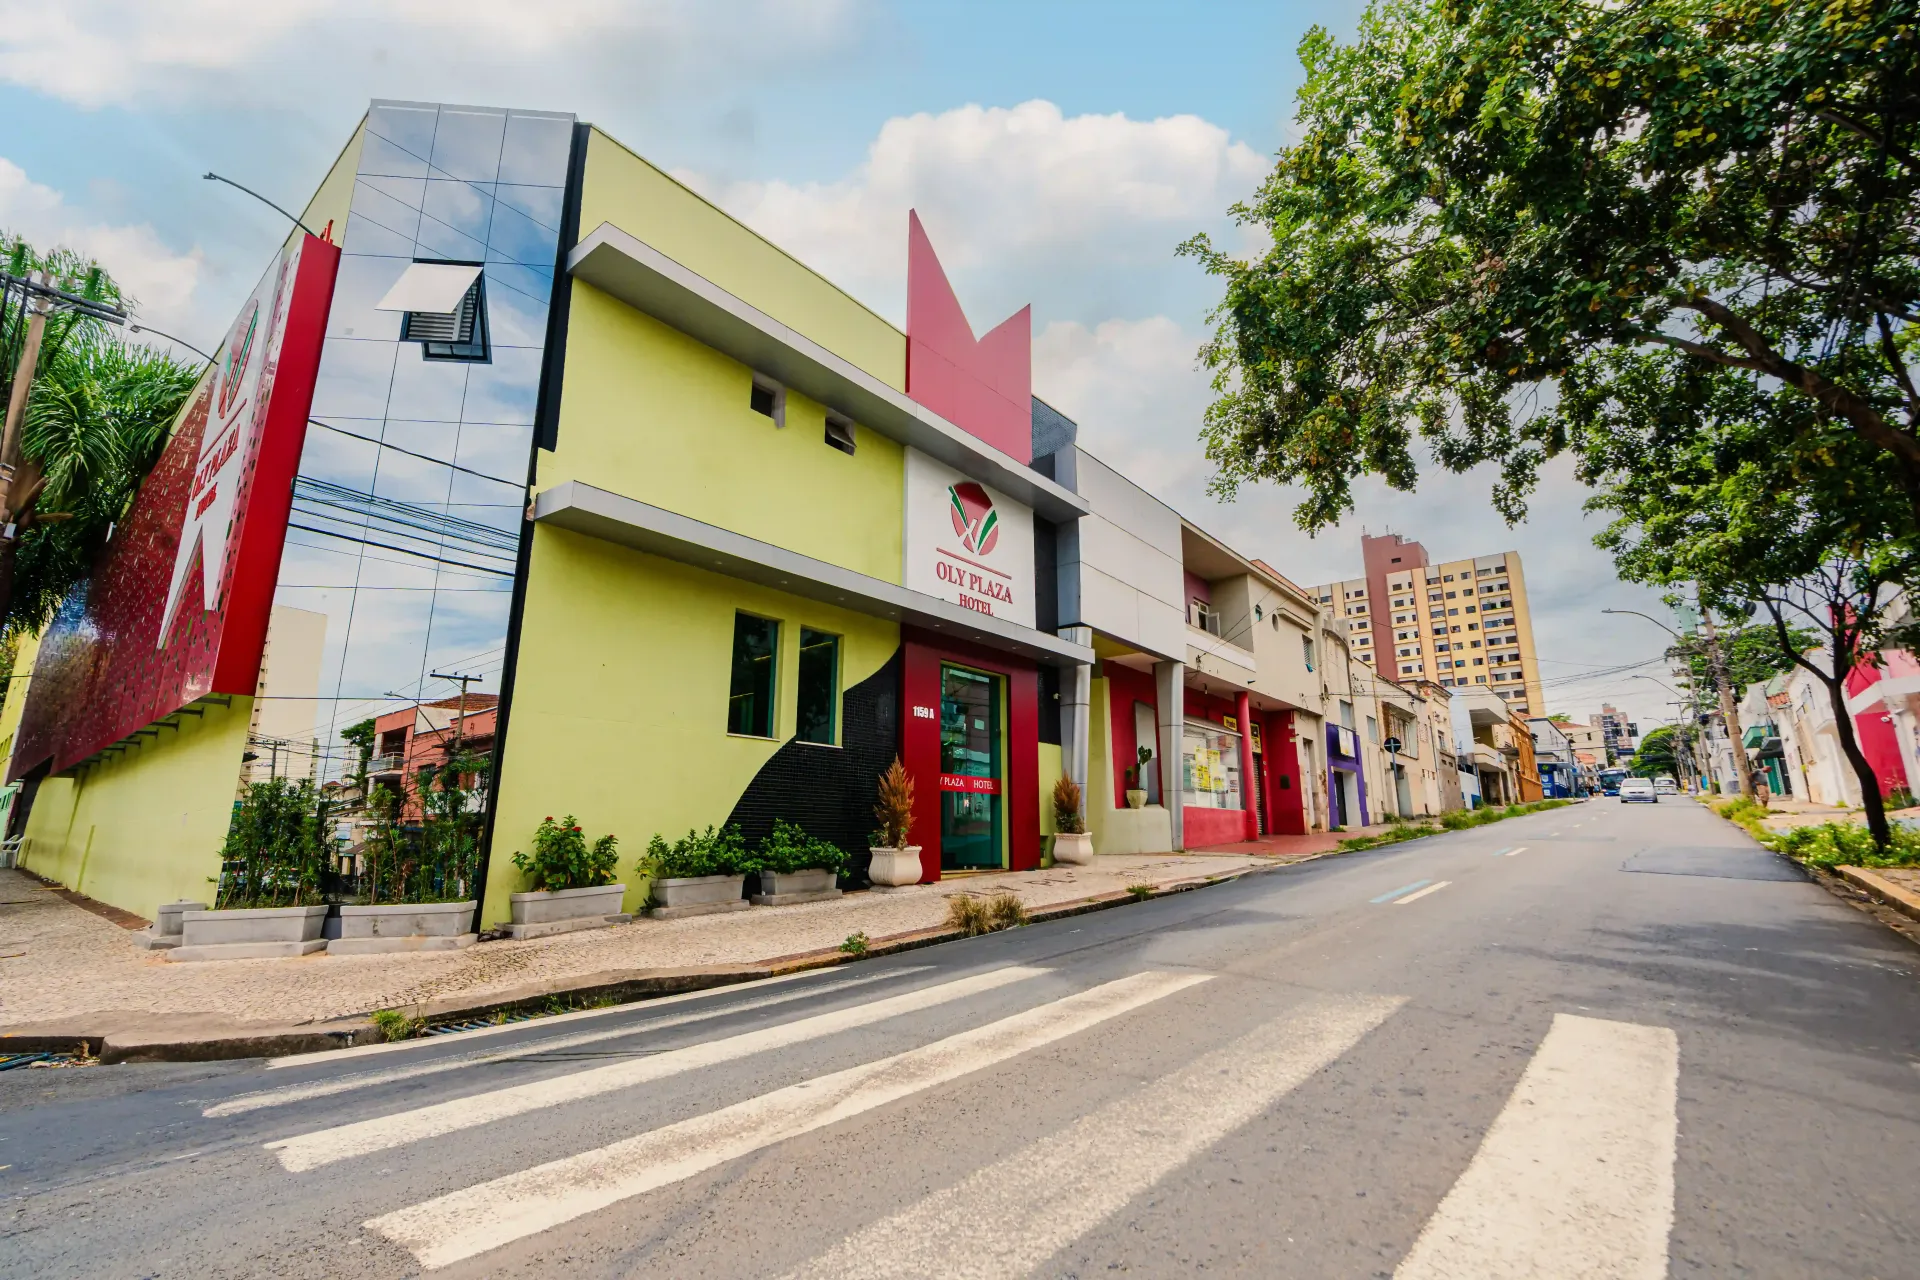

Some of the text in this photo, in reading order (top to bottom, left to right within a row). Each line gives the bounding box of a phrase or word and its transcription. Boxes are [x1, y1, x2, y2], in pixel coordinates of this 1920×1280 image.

[207, 423, 241, 483] PLAZA
[936, 561, 1014, 605] OLY PLAZA
[959, 593, 994, 617] HOTEL
[912, 705, 935, 720] 1159 A
[944, 776, 965, 788] PLAZA
[973, 779, 994, 790] HOTEL
